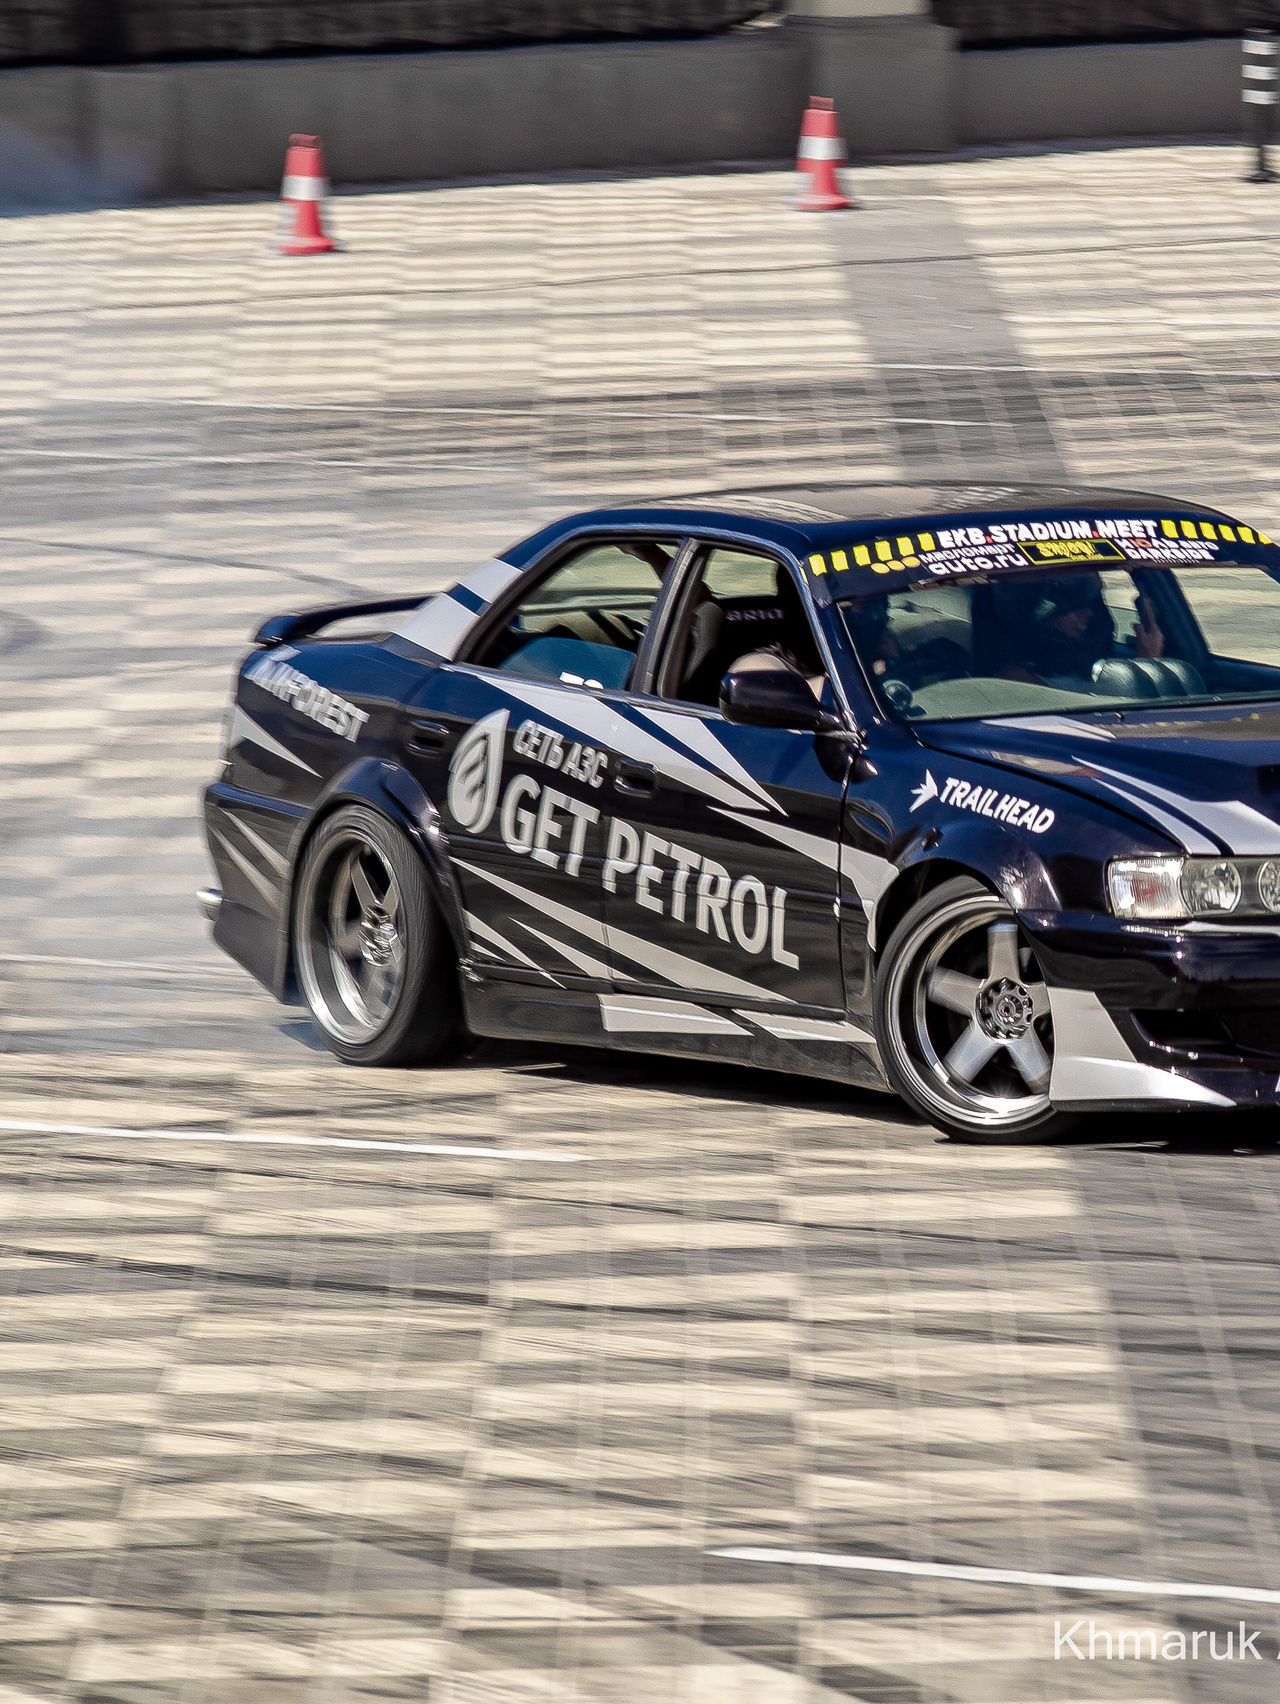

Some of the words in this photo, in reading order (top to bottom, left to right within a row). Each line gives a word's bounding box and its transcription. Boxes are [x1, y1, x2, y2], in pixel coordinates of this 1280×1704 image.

[927, 553, 1029, 575] auto.ru
[1124, 548, 1215, 561] DARKSIDE
[939, 777, 1055, 834] TRAILHEAD
[500, 774, 601, 878] GET
[601, 816, 800, 971] PETROL
